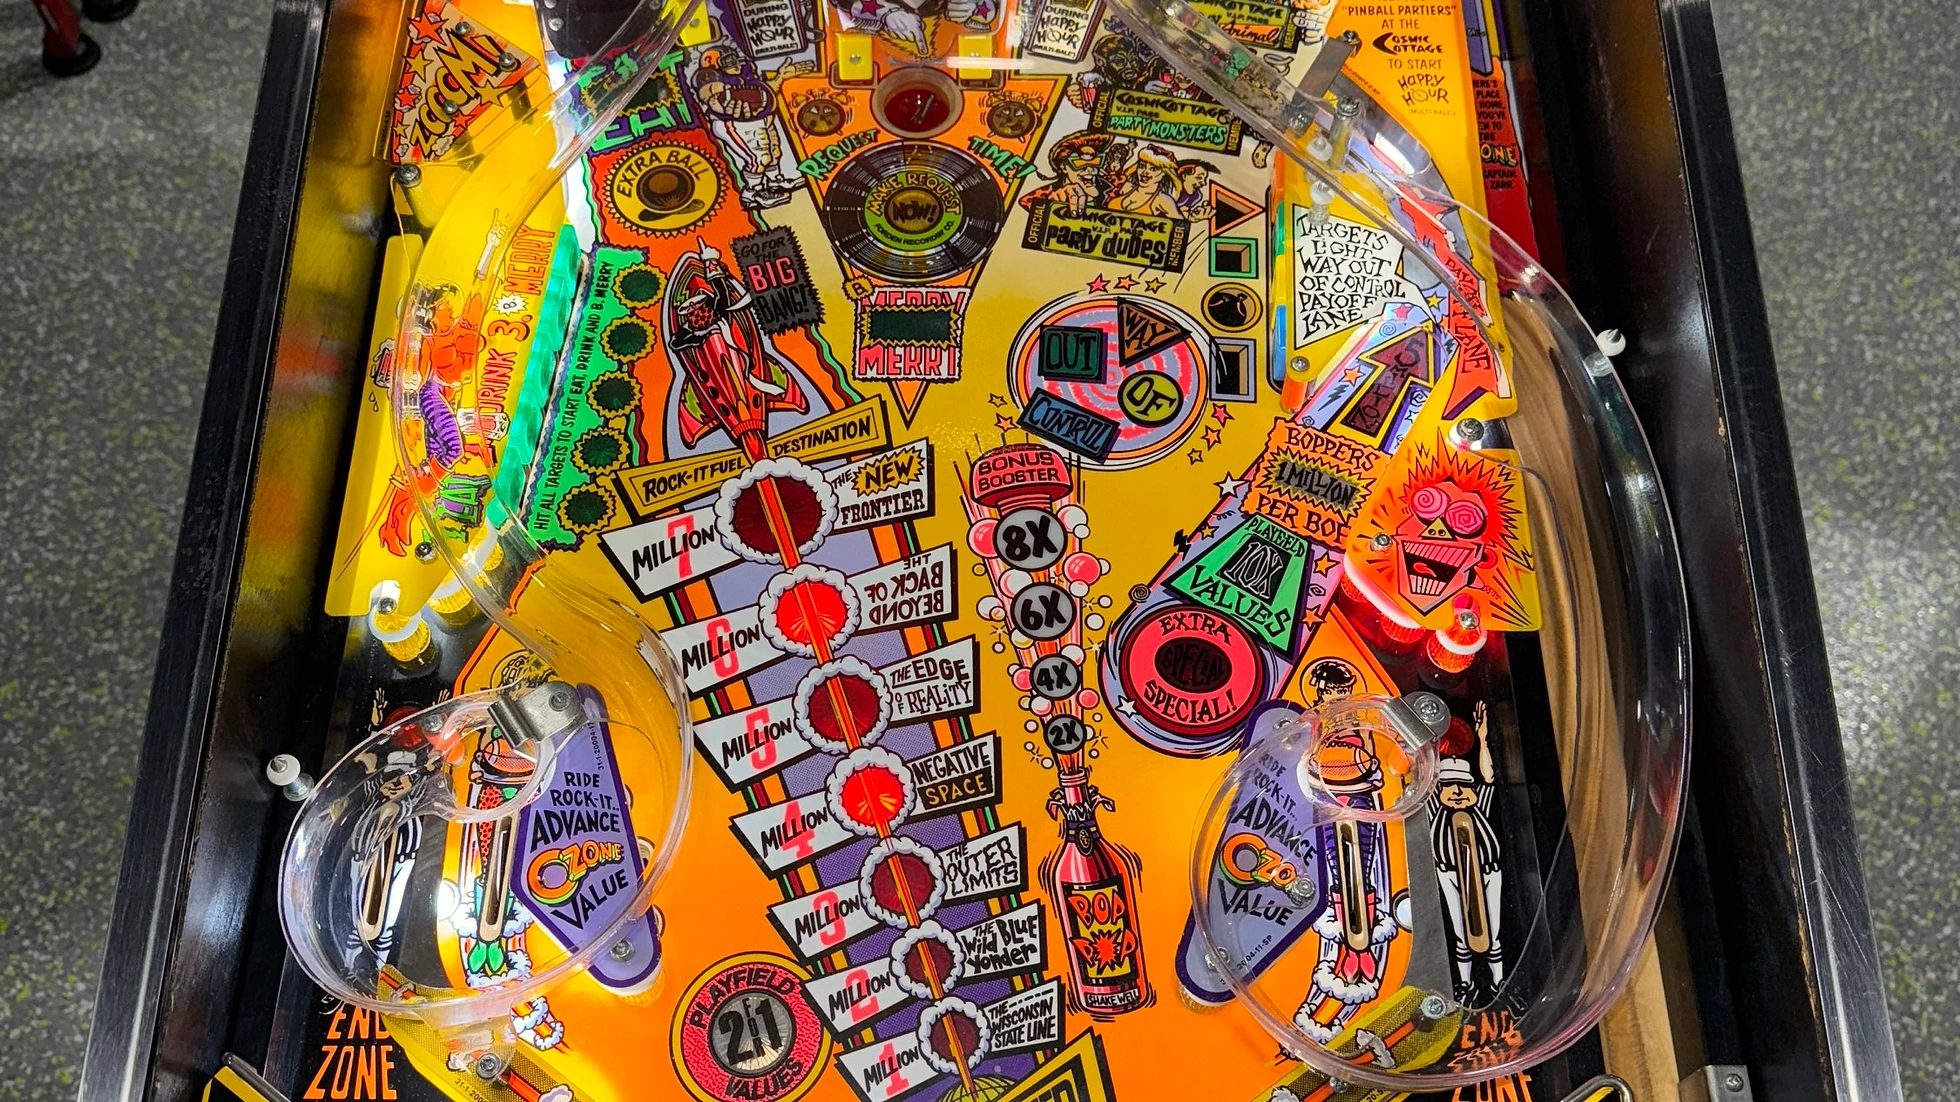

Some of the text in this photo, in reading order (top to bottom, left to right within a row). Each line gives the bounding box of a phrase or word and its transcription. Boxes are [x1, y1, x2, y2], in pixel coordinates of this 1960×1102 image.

[744, 2, 789, 16] DURING
[1044, 6, 1089, 21] DURING
[1382, 20, 1420, 30] AT THE
[1388, 59, 1442, 70] TO START
[1092, 91, 1110, 128] OFFICIAL
[1110, 115, 1227, 145] PARTY MONSTERS
[617, 150, 710, 198] EXTRA BALL
[798, 129, 880, 181] REQUEST
[968, 136, 1038, 184] TIME!
[868, 172, 960, 216] MAKE REQUEST
[892, 200, 938, 223] NOW!
[1028, 204, 1045, 244] OFFICIAL
[1296, 214, 1390, 250] TARGETS
[504, 224, 556, 296] MERRY
[740, 236, 786, 258] GO FOR
[754, 250, 780, 262] THE
[1296, 246, 1392, 278] WAY OUT
[1311, 238, 1372, 260] LIGHT
[746, 256, 798, 294] BIG
[1300, 275, 1406, 298] OF CONTROL
[756, 284, 810, 324] BANG!
[1298, 291, 1378, 314] PAYOFF
[1124, 309, 1174, 350] WAY
[1302, 308, 1363, 340] LANE
[1044, 333, 1096, 371] OUT
[1454, 324, 1492, 374] LANE
[534, 260, 614, 530] HIT ALL TARGETS TO START EAT, DRINK AND B. MERRY
[1126, 376, 1178, 417] OF
[772, 418, 871, 456] DESTINATION
[1028, 396, 1112, 450] CONTROL
[978, 452, 1054, 476] BONUS
[1285, 427, 1380, 472] BOPPERS
[642, 456, 746, 502] ROCK-IT FUEL
[832, 456, 914, 490] THE NEW
[978, 468, 1061, 492] BOOSTER
[1275, 462, 1358, 510] 1 MILLION
[842, 488, 926, 525] FRONTIER
[1256, 492, 1299, 529] PER
[632, 514, 715, 581] 7 MILLION
[1002, 515, 1058, 561] 8X
[1244, 518, 1306, 558] PLAYFIELD
[1020, 590, 1066, 631] 6X
[1190, 565, 1292, 638] VALUES
[682, 618, 760, 680] 6 MILLION
[1160, 612, 1232, 646] EXTRA
[890, 657, 970, 686] THE EDGE
[1036, 662, 1072, 691] 4X
[904, 681, 973, 714] REALITY
[1144, 679, 1238, 724] SPECIAL!
[720, 717, 792, 770] MILLION
[1049, 720, 1080, 746] 2X
[564, 772, 600, 788] RIDE
[913, 740, 991, 784] NEGATIVE
[1258, 752, 1287, 778] RIDE
[925, 774, 988, 806] SPACE
[530, 808, 620, 853] ADVANCE
[760, 800, 829, 858] 4 MILLION
[1230, 798, 1318, 868] ADVANCE
[526, 840, 623, 906] OZONE
[946, 836, 1018, 884] THE OUTER
[951, 861, 1019, 897] LIMITS
[550, 868, 628, 930] VALUE
[1068, 890, 1126, 930] BOP
[1218, 878, 1294, 928] VALUE
[794, 894, 860, 945] MILLION
[972, 922, 994, 937] THE
[961, 932, 998, 956] Wild
[690, 967, 796, 1030] PLAYFIELD
[828, 969, 890, 1024] 2 MILLION
[990, 1002, 1008, 1017] THE
[990, 997, 1052, 1033] WISCONSIN
[1088, 990, 1140, 1007] SHAKE WELL
[718, 1010, 754, 1066] 2
[754, 998, 784, 1050] 1
[994, 1016, 1056, 1048] STATE LINE
[303, 1045, 399, 1100] ZONE
[724, 1058, 804, 1100] VALUES
[863, 1042, 919, 1096] 1 MILLION
